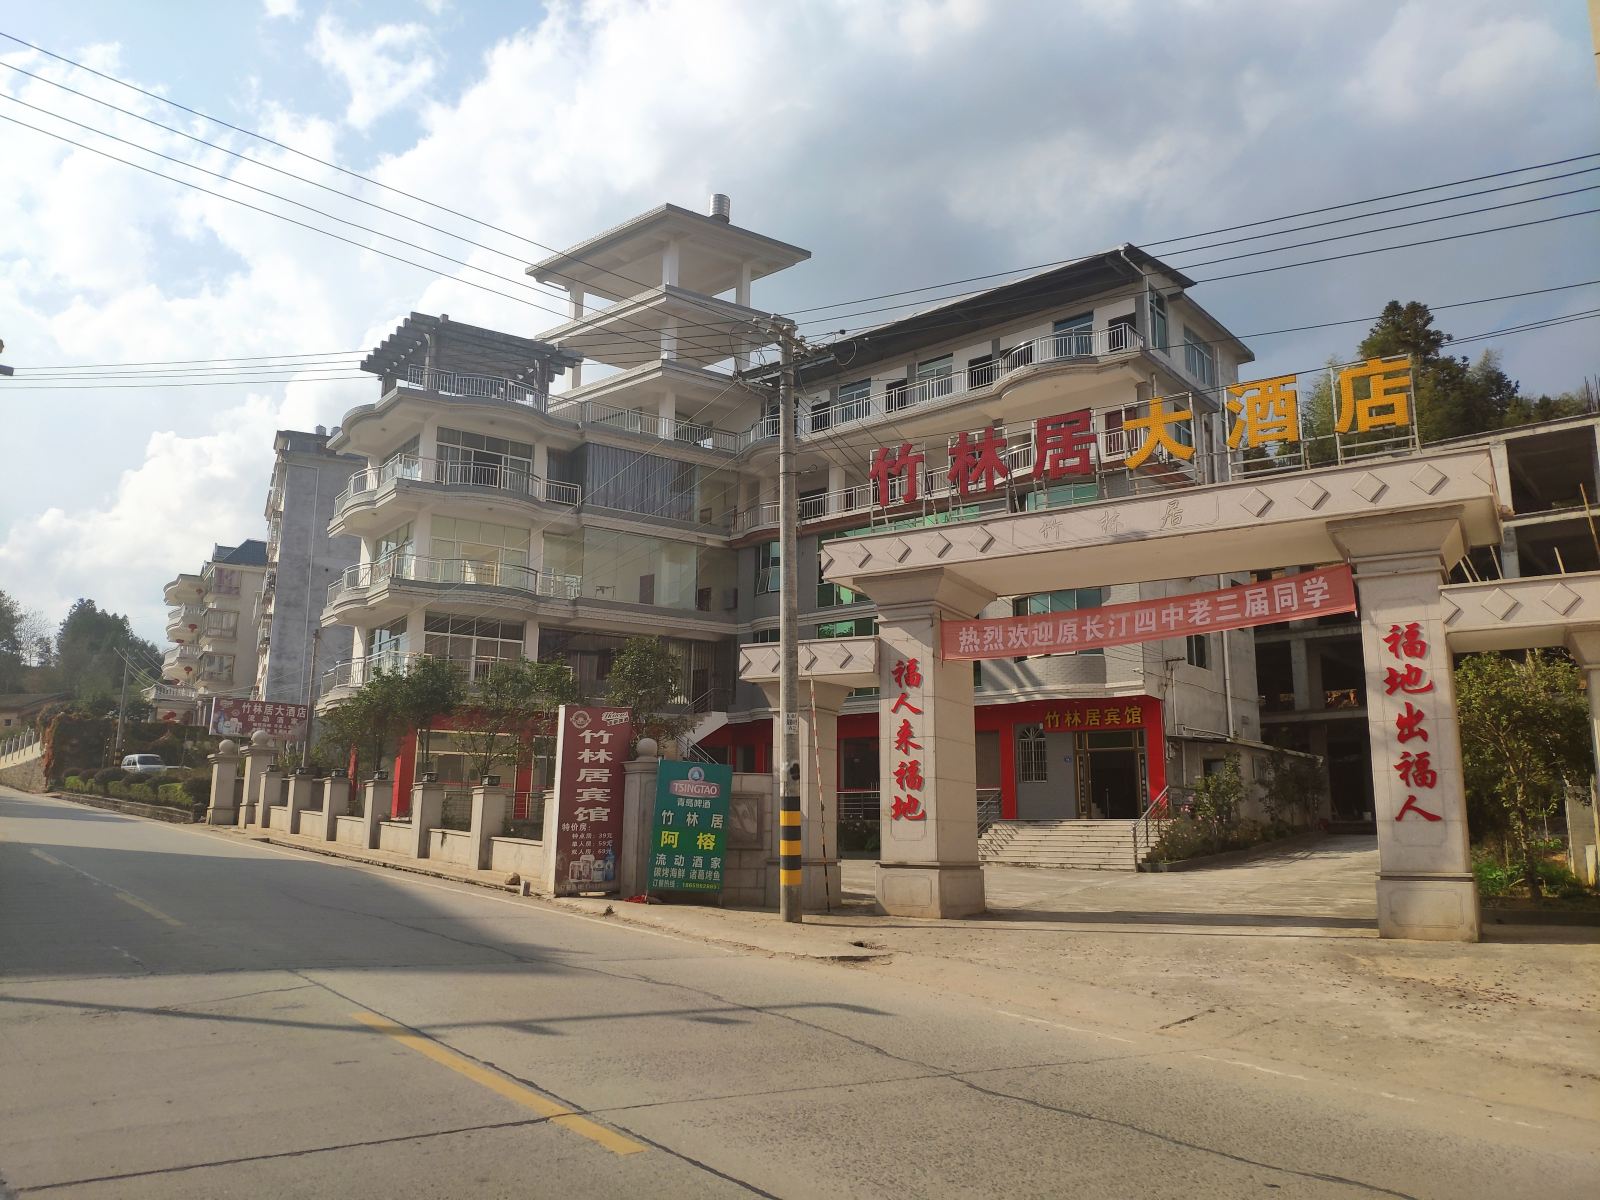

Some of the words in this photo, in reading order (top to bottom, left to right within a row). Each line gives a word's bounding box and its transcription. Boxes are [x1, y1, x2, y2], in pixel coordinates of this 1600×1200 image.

[869, 355, 1413, 508] 竹林居大酒店
[1039, 499, 1183, 540] 竹林居
[957, 575, 1331, 654] 热烈欢迎原长汀四中老三届同学
[242, 702, 307, 719] 竹林居大酒店
[1044, 705, 1143, 728] 竹林居宾馆
[1382, 622, 1442, 823] 福地出福人
[890, 657, 926, 822] 福人来福地
[574, 729, 613, 822] 竹林居宾馆
[673, 782, 718, 795] TSINGTAO
[677, 798, 711, 809] 青岛啤酒
[661, 810, 724, 829] 竹林居
[660, 830, 716, 851] 阿榕
[655, 853, 721, 869] 流动酒家
